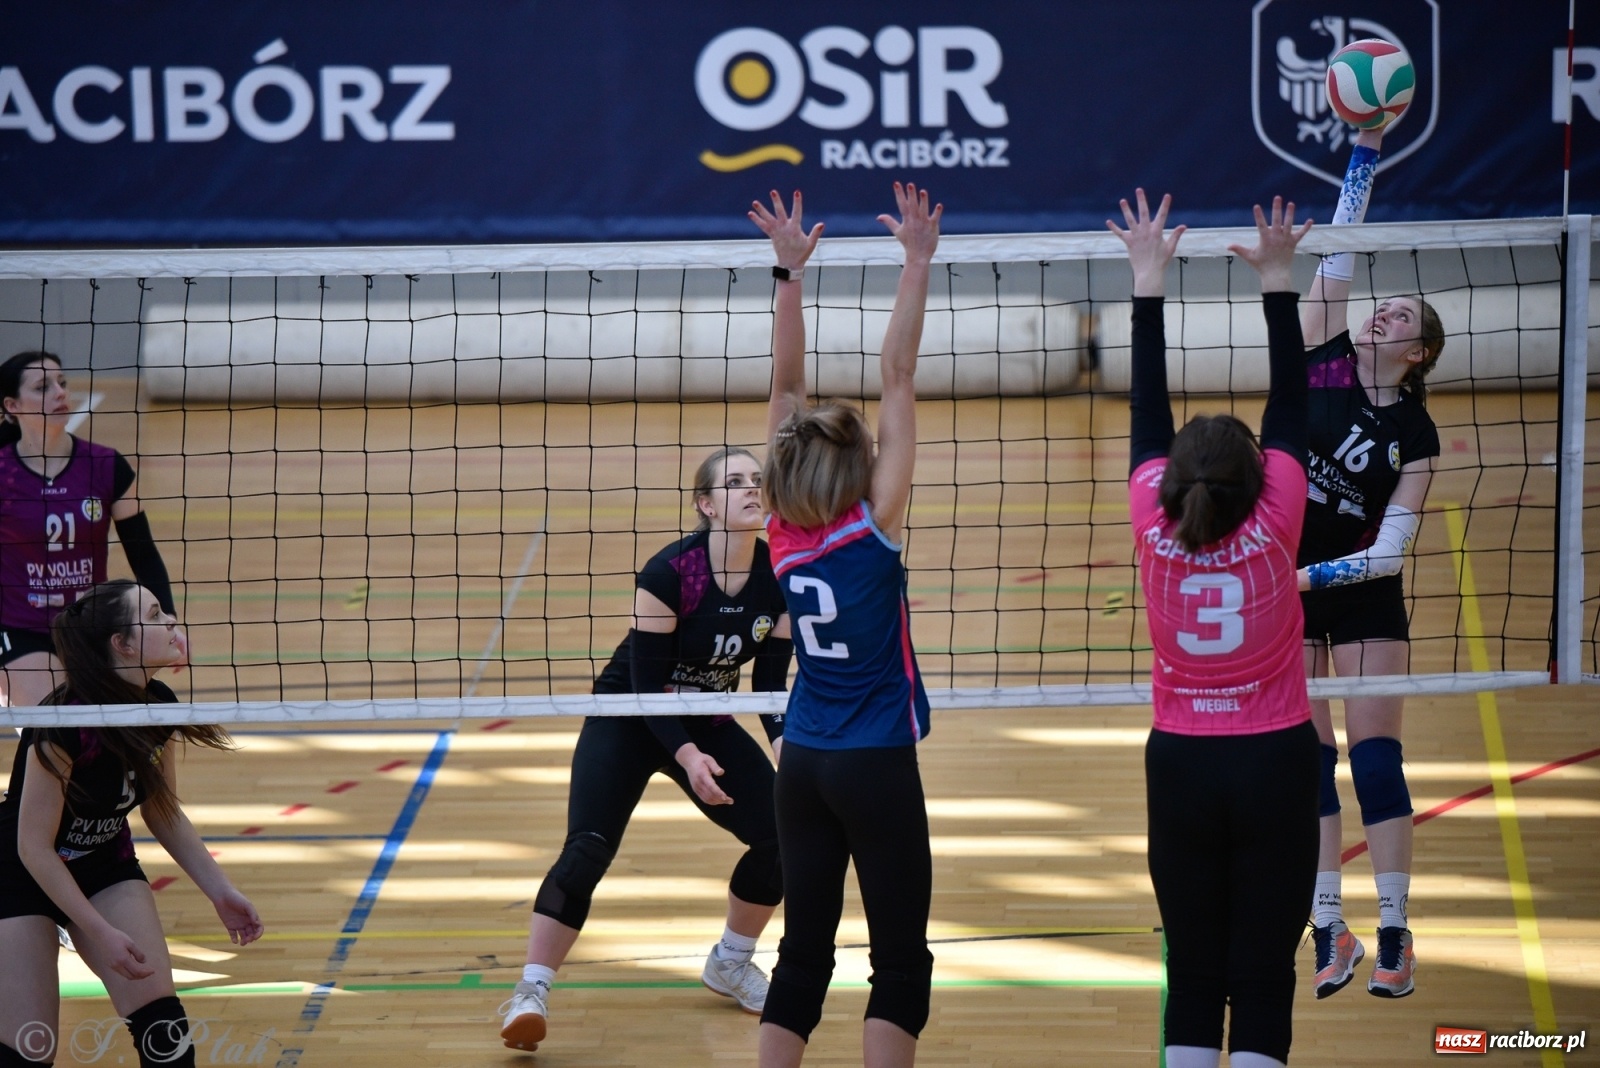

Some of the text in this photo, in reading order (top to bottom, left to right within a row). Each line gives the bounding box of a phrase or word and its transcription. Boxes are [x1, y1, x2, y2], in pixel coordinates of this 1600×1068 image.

[694, 25, 1009, 131] OSiR
[820, 130, 1010, 169] RACIBÓRZ
[1332, 424, 1376, 473] 16
[46, 512, 76, 552] 21
[26, 562, 44, 578] PV
[789, 574, 850, 659] 2
[1176, 572, 1245, 656] 3
[708, 634, 743, 666] 12
[1192, 698, 1241, 714] WĘGIEL
[71, 817, 96, 833] PV
